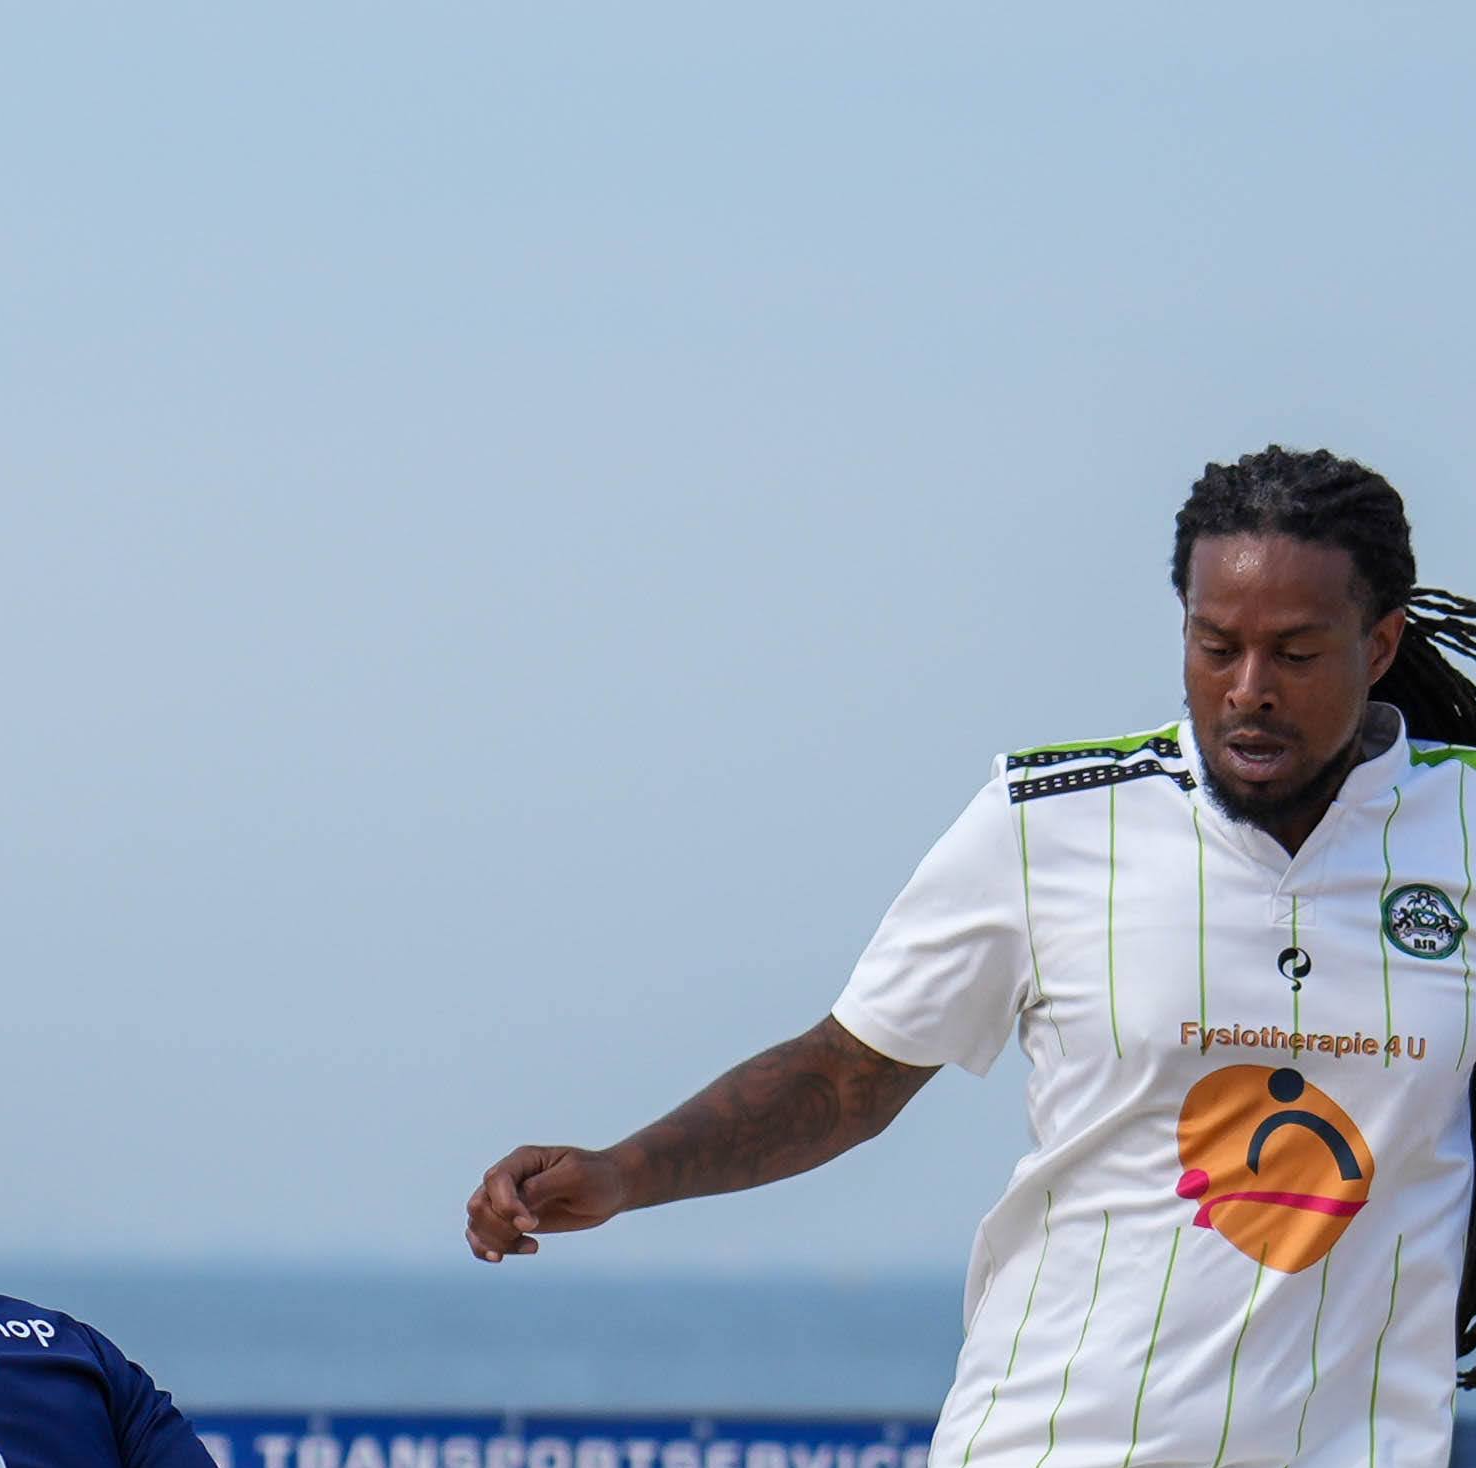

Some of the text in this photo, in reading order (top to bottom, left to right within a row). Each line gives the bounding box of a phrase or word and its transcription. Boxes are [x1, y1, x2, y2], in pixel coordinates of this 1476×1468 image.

[1180, 1021, 1427, 1061] Fysiotherapie 4 U
